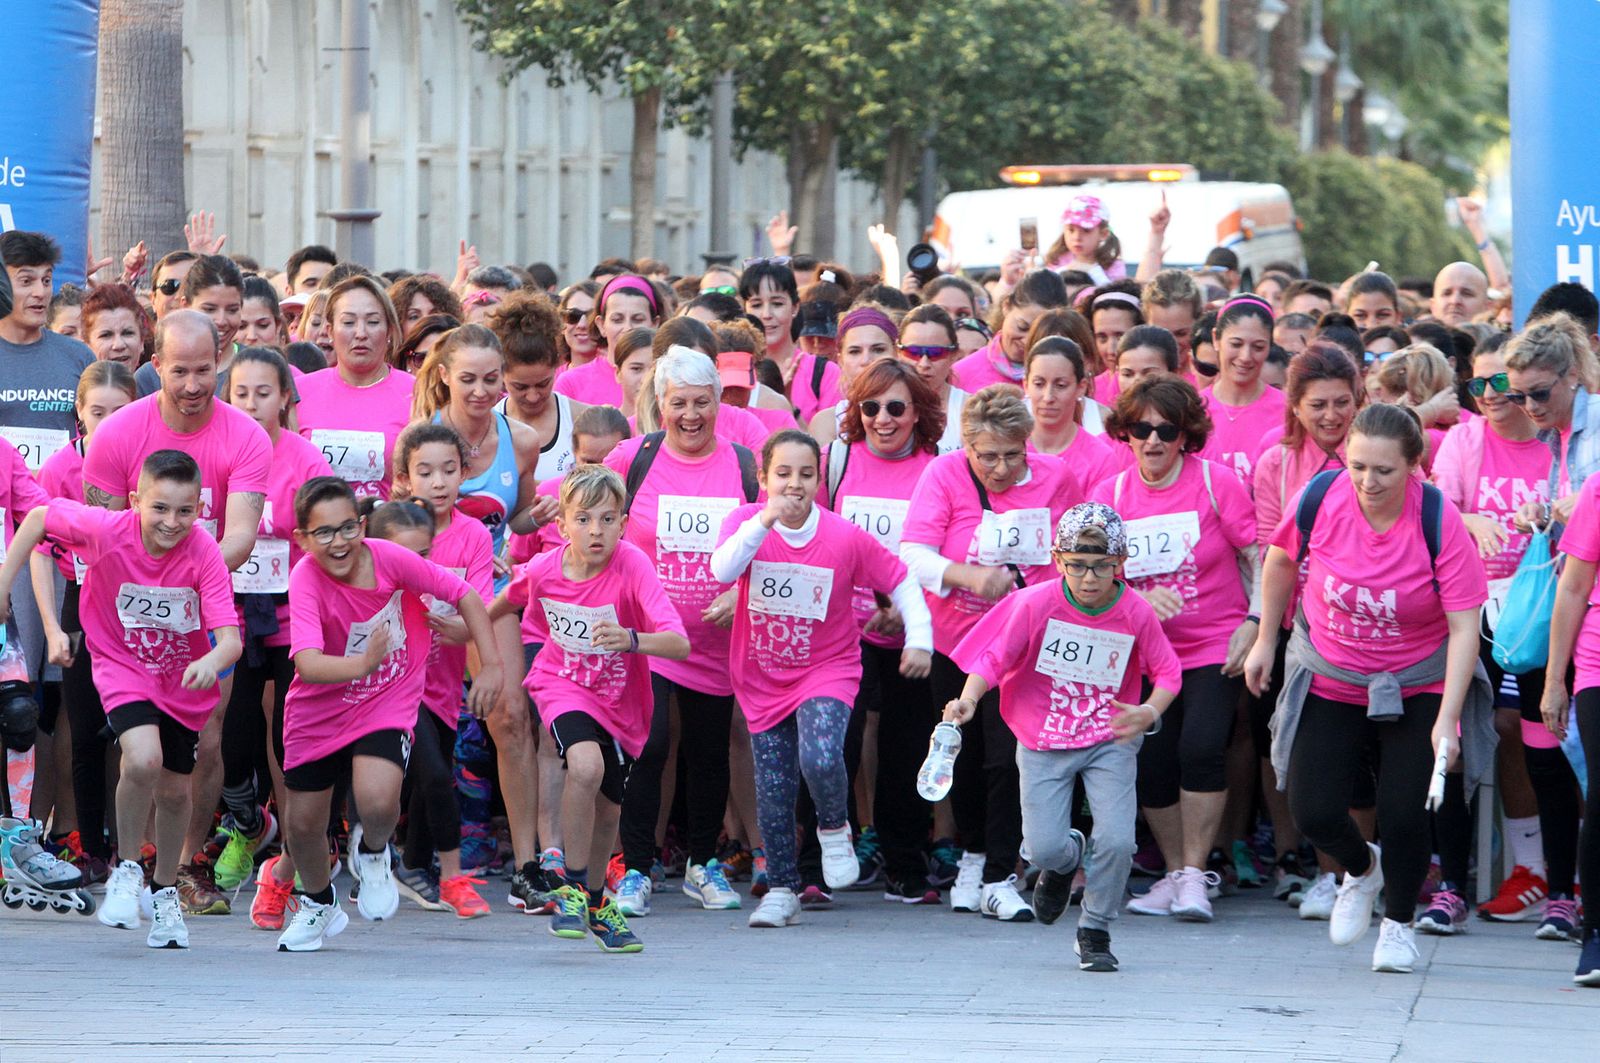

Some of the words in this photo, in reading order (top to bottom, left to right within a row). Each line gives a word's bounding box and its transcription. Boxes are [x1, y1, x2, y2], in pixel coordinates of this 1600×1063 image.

[0, 157, 26, 187] de
[1556, 199, 1600, 235] Ayu
[1556, 245, 1600, 293] H
[29, 401, 74, 412] CENTER
[322, 445, 349, 465] 57
[1478, 476, 1551, 510] KM
[665, 511, 710, 534] 108
[996, 527, 1020, 548] 13
[1128, 532, 1171, 558] 512
[657, 563, 719, 582] ELLA
[761, 577, 793, 599] 86
[1323, 575, 1397, 619] KM
[122, 594, 171, 618] 725
[548, 611, 590, 640] 322
[1045, 638, 1094, 665] 481
